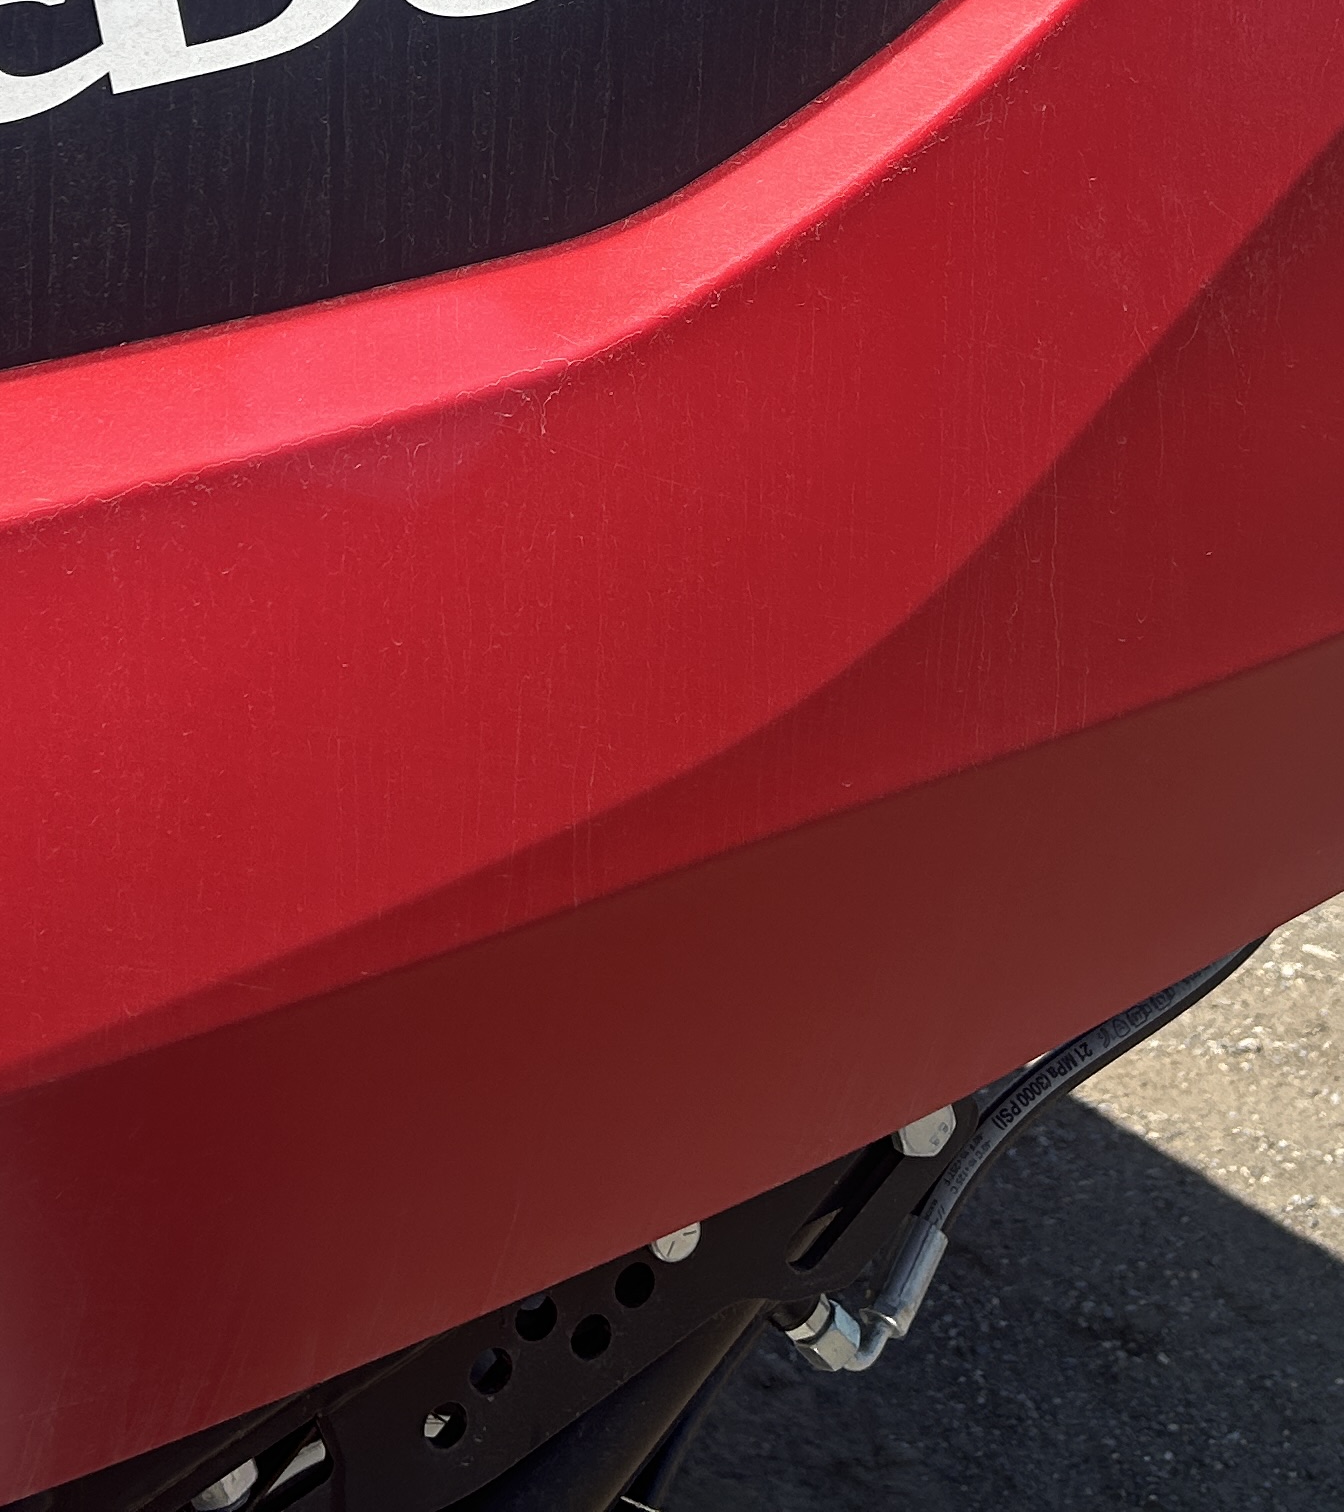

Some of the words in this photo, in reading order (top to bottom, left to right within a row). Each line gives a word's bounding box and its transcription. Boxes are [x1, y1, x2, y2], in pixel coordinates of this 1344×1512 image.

[1047, 1053, 1078, 1078] MPa
[1074, 1041, 1094, 1062] 21
[1015, 1073, 1053, 1107] (3000
[991, 1100, 1022, 1131] PSI)
